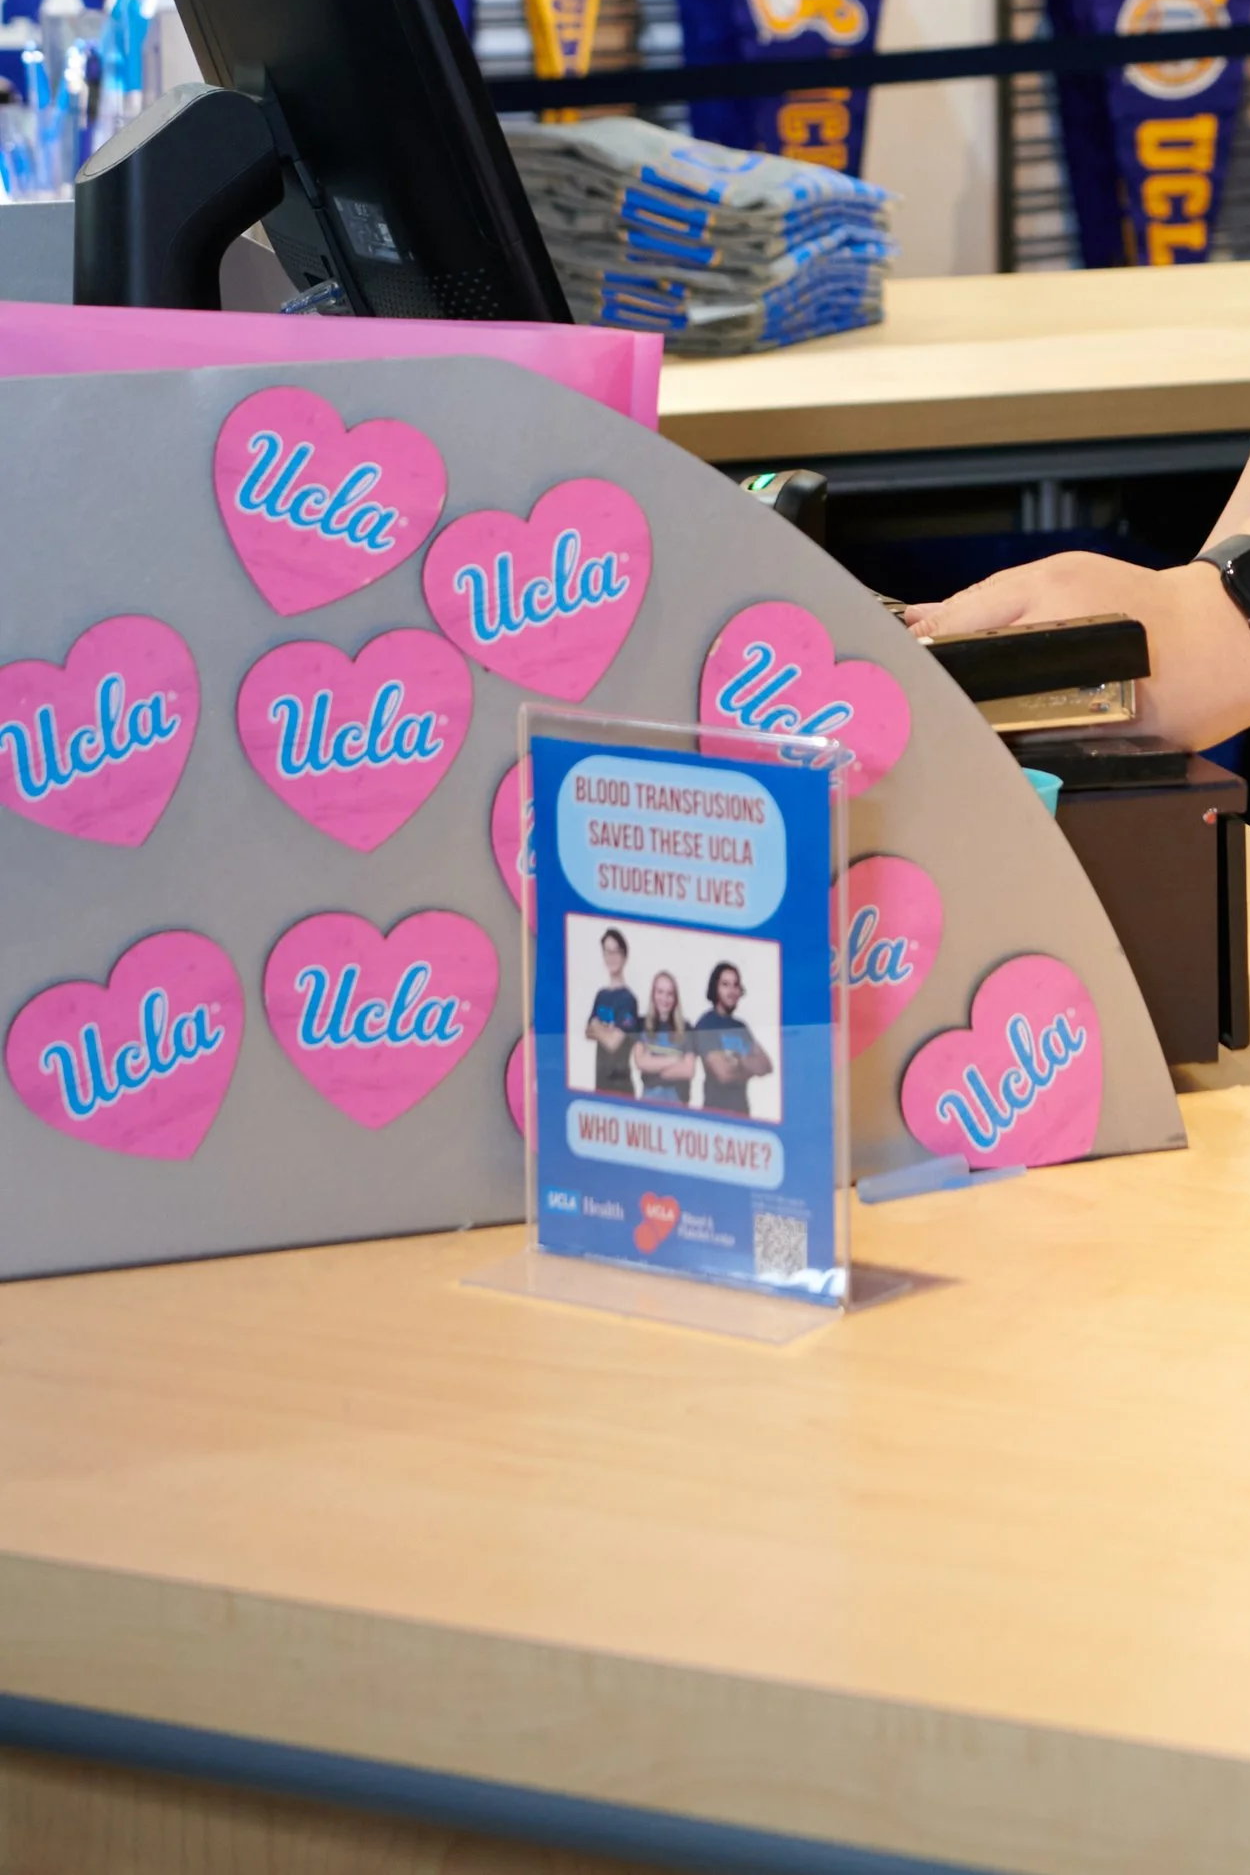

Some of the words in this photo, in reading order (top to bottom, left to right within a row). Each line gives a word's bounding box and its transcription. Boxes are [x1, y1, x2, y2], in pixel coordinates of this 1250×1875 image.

[235, 431, 398, 551] Ucla
[455, 529, 630, 641] Ucla
[0, 673, 180, 801] Ucla
[270, 680, 443, 779] Ucla
[575, 776, 630, 807] BLOOD
[637, 784, 765, 825] TRANSFUSIONS
[589, 820, 644, 851] SAVED
[650, 827, 703, 859] THESE
[709, 835, 753, 866] UCLA
[598, 863, 690, 900] STUDENTS'
[697, 877, 745, 908] LIVES
[296, 961, 463, 1050] Ucla
[40, 987, 225, 1121] Ucla
[936, 1013, 1086, 1153] Ucla
[578, 1112, 620, 1143] WHO
[625, 1121, 667, 1155] WILL
[673, 1128, 709, 1161] YOU
[714, 1135, 772, 1171] SAVE?
[548, 1191, 578, 1211] UCLA
[583, 1196, 625, 1221] Health
